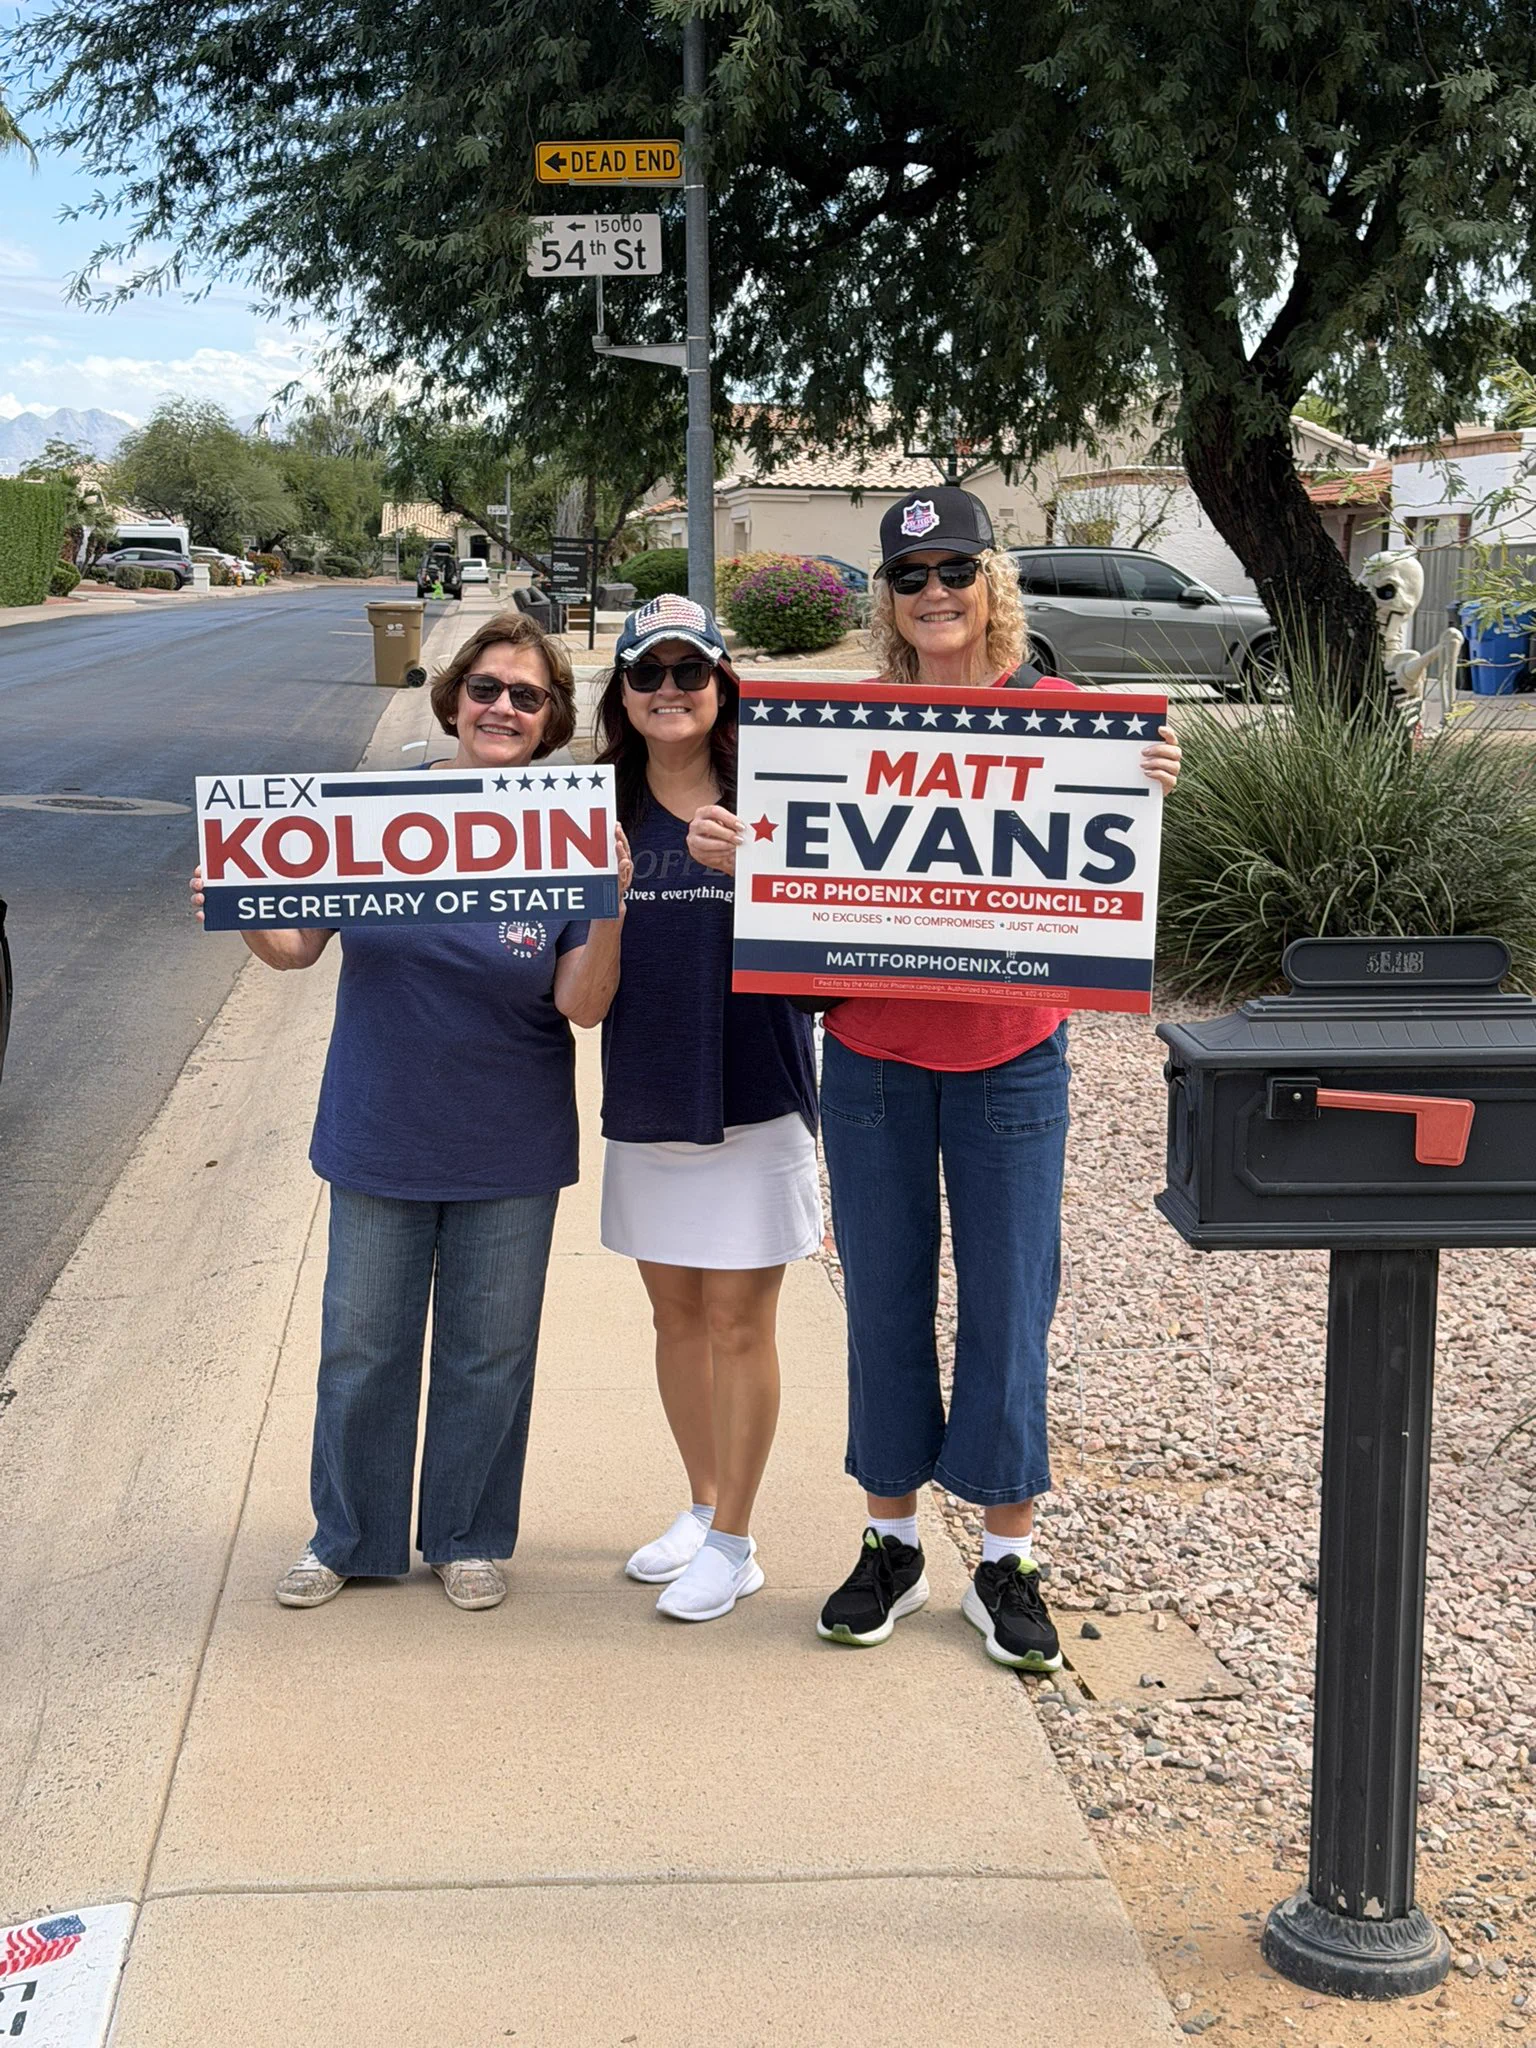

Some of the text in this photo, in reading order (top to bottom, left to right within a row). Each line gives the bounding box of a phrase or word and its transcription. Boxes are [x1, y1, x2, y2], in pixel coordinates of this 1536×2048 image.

[572, 150, 675, 172] DEAD END
[595, 219, 642, 233] 15000
[542, 239, 647, 272] 54th St
[864, 750, 1045, 802] MATT
[204, 776, 318, 810] ALEX
[203, 807, 609, 880] KOLODIN
[785, 800, 1137, 885] EVANS
[237, 891, 425, 921] SECRETARY
[435, 889, 479, 914] OF
[489, 887, 586, 912] STATE
[622, 888, 656, 901] olves
[661, 886, 734, 903] everything
[771, 881, 1123, 915] FOR PHOENIX CITY COUNCIL D2
[523, 927, 537, 940] AZ
[812, 911, 1079, 934] NO EXCUSES NO COMPROMISES JUST ACTION
[512, 948, 532, 958] 250
[826, 951, 1049, 977] MATTFORPHOENIX.COM
